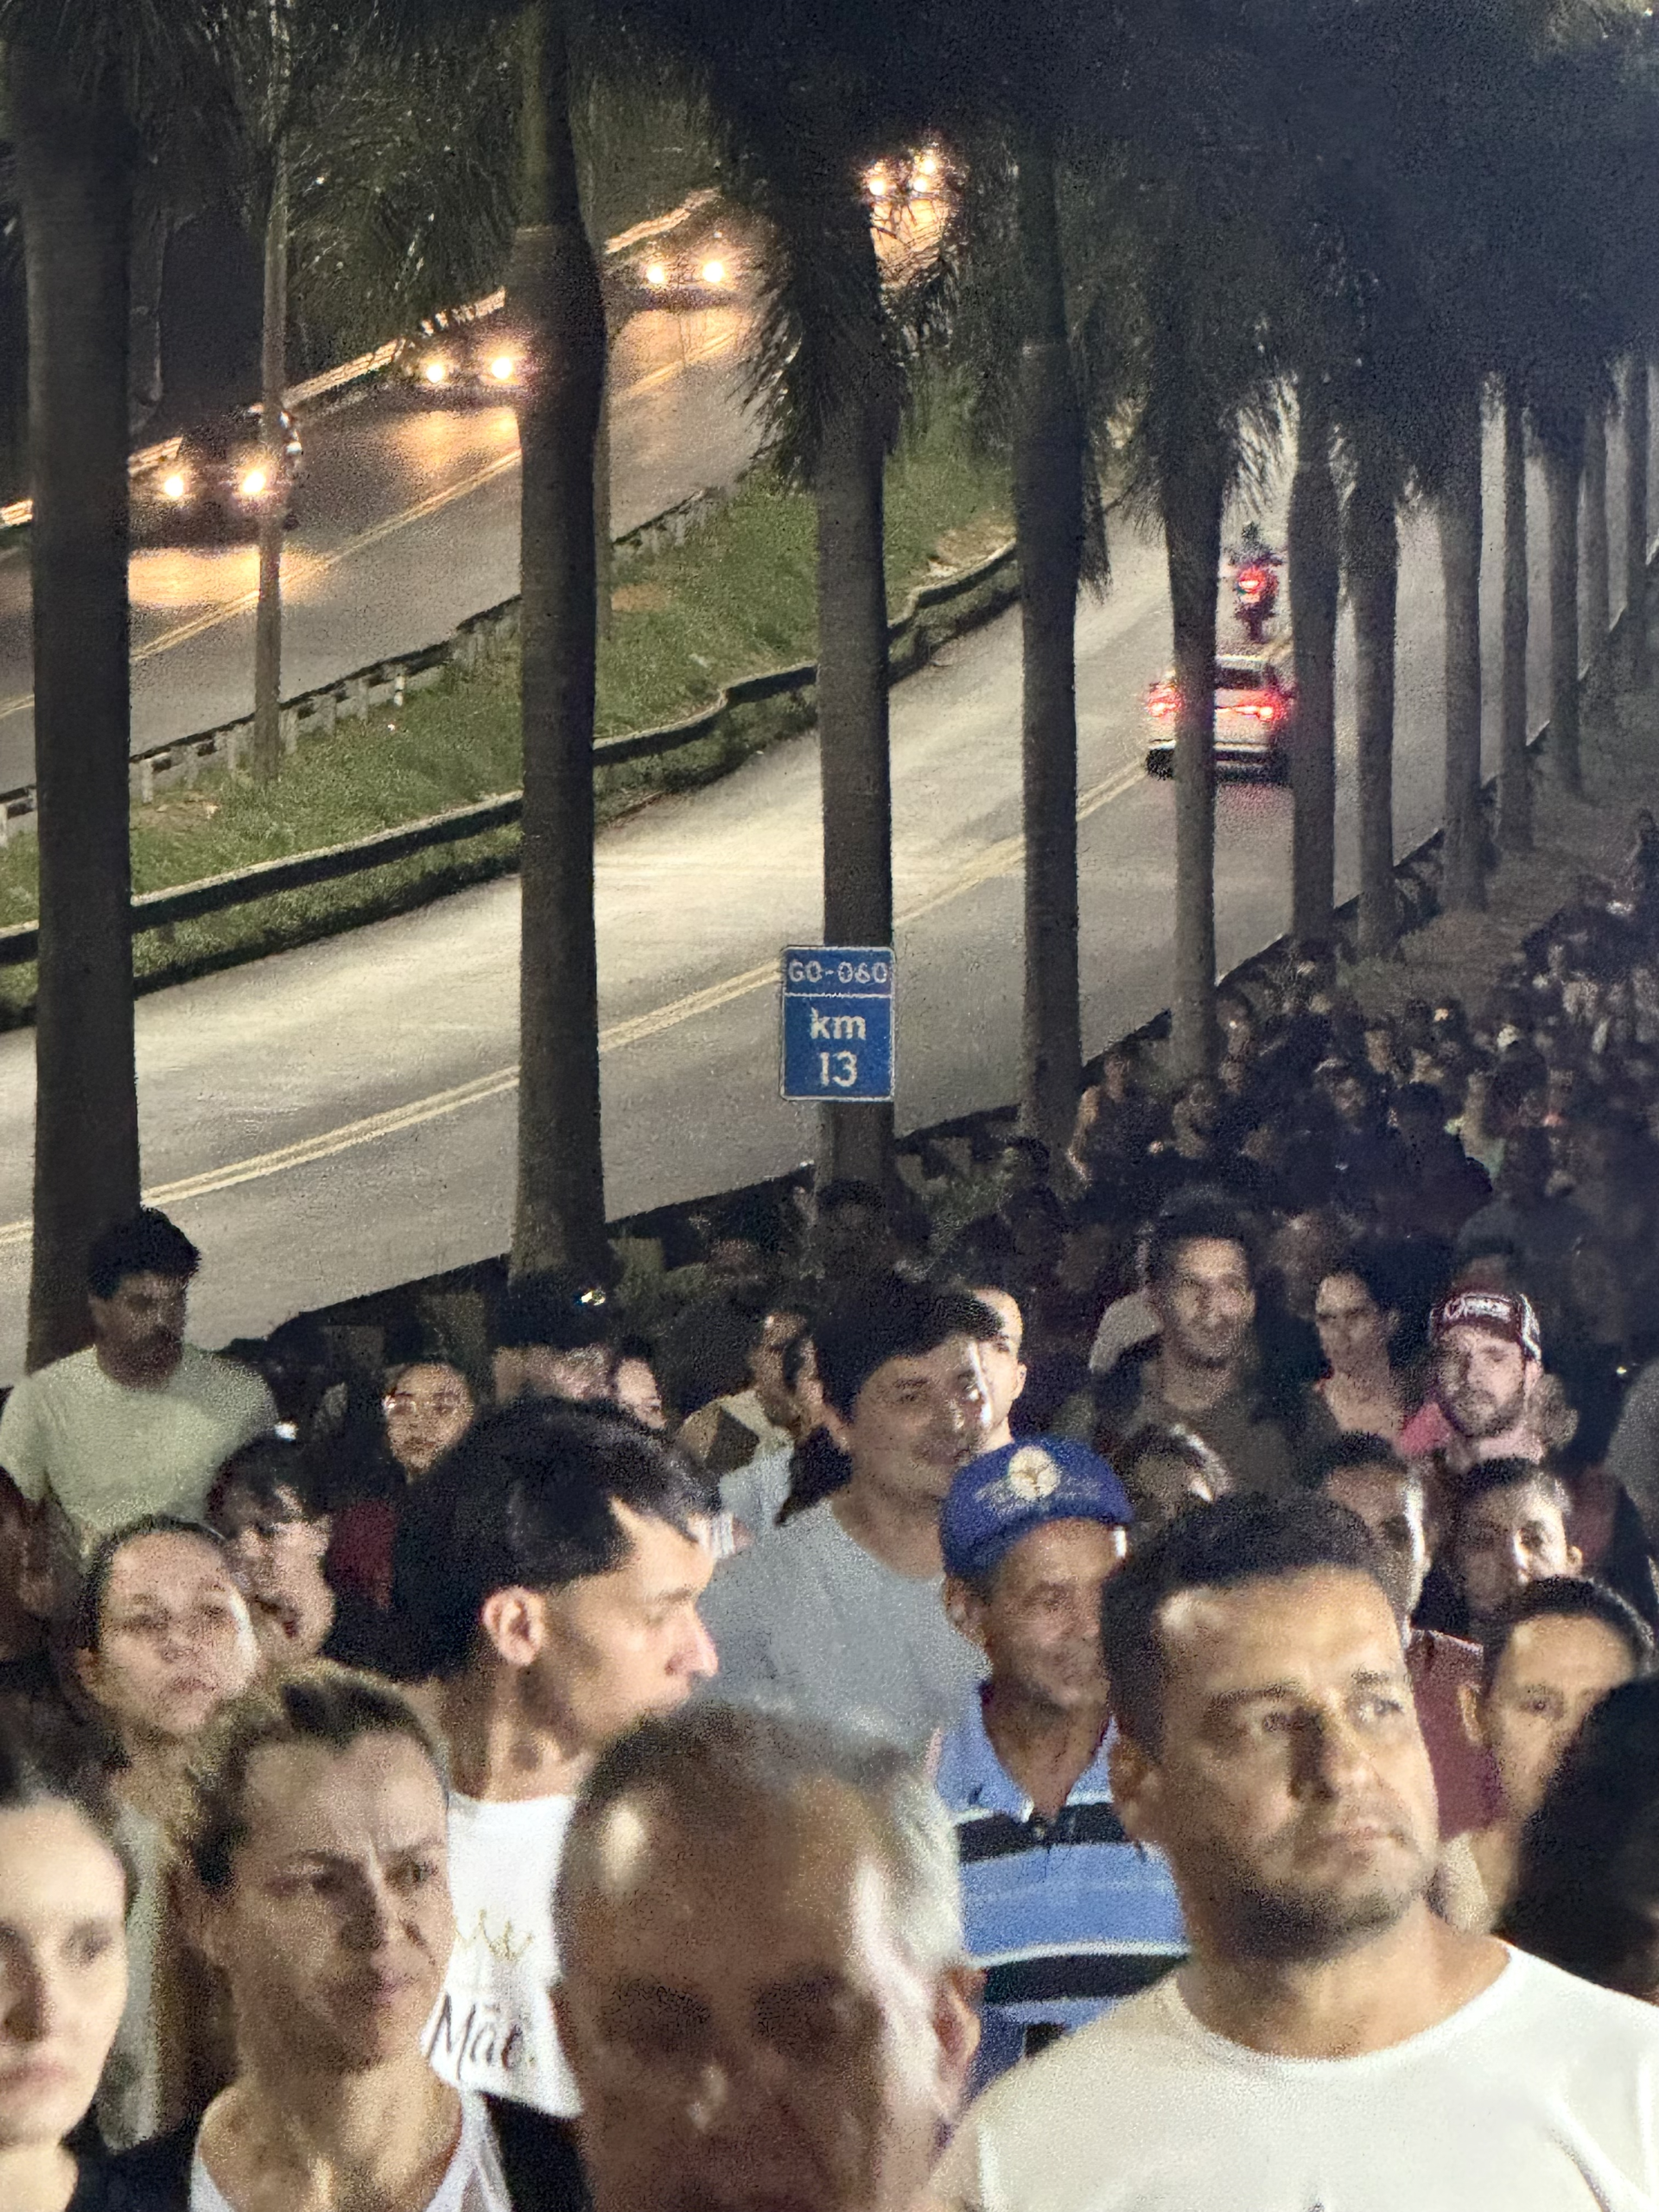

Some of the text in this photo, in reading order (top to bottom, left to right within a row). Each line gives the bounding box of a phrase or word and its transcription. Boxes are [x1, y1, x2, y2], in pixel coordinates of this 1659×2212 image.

[788, 959, 888, 984] GO-060
[810, 1007, 867, 1040] km
[819, 1051, 858, 1088] 13
